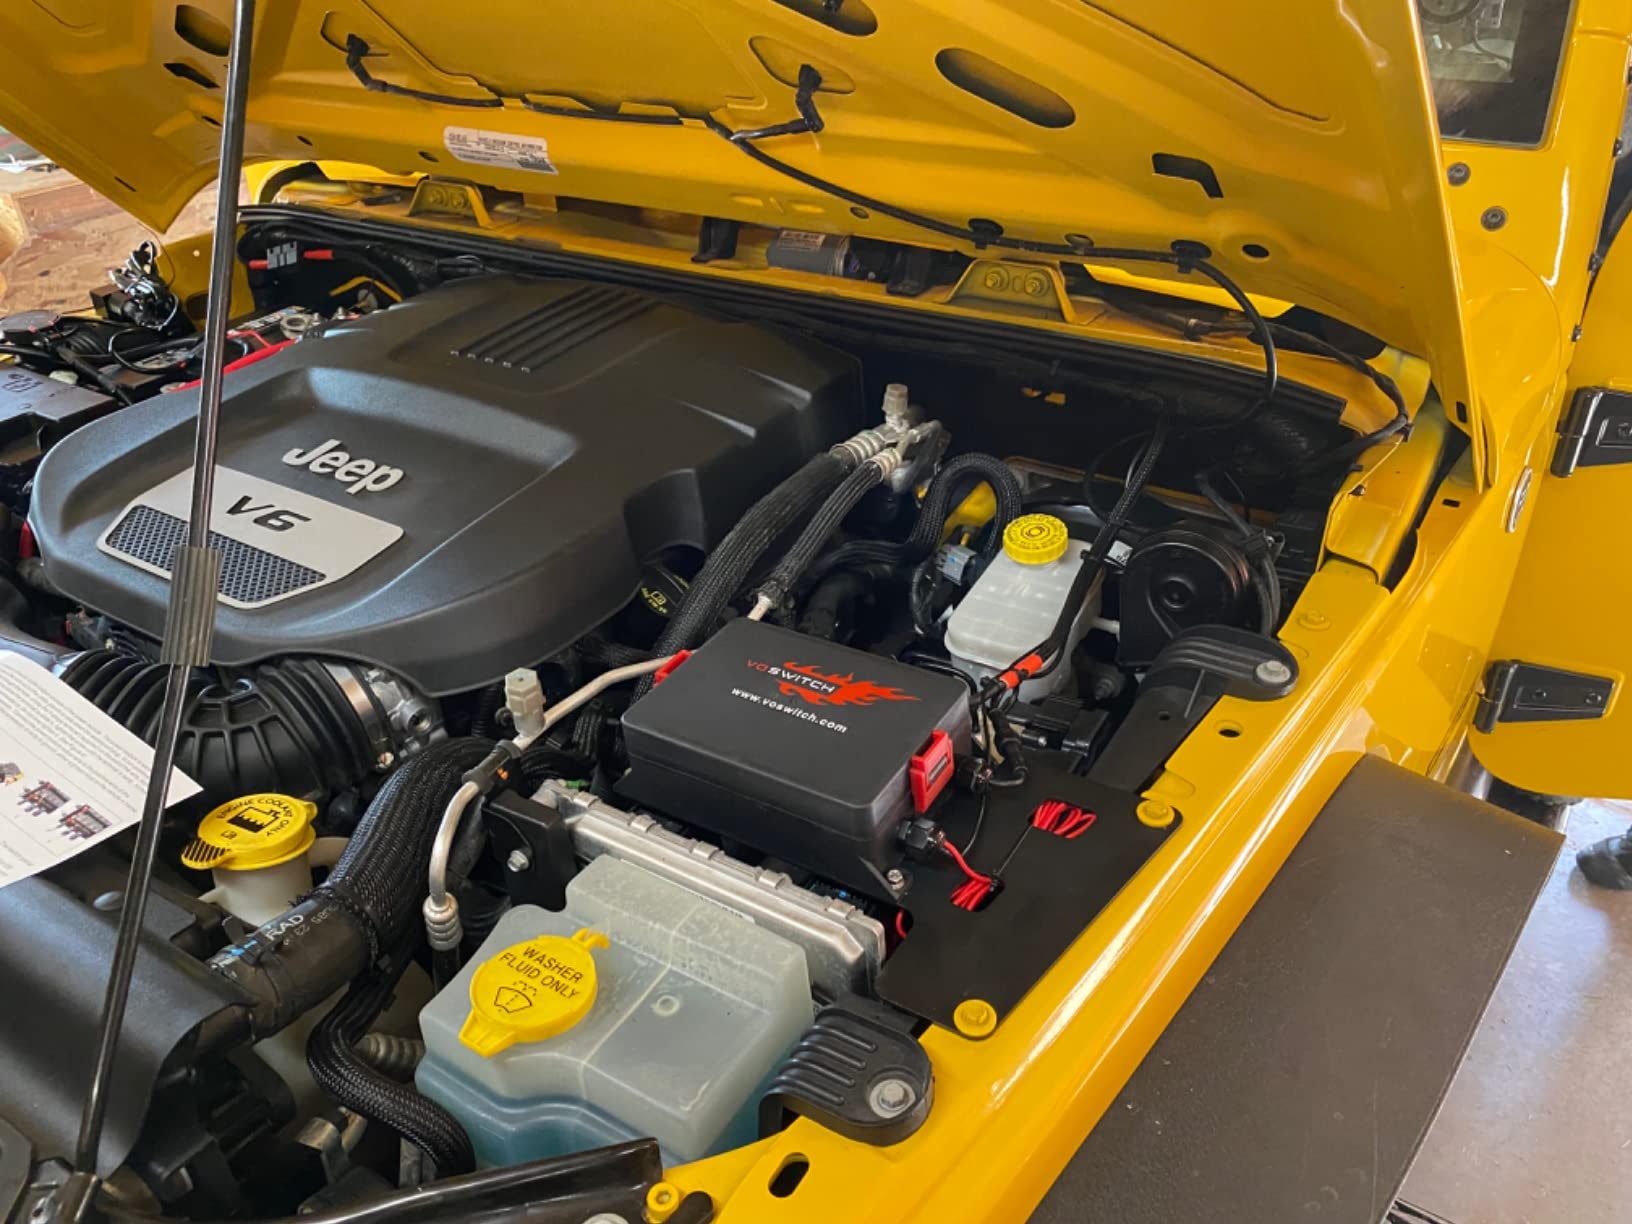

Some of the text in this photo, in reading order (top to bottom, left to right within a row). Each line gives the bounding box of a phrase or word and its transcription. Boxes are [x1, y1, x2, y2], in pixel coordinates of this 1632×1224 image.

[281, 438, 404, 495] Jeep
[226, 495, 312, 532] V6
[747, 660, 836, 693] VOSWITCH
[731, 687, 848, 733] www.voswitch.com
[265, 914, 304, 941] RAD
[500, 952, 581, 1000] FLUID ONLY
[523, 946, 584, 983] WASHER
